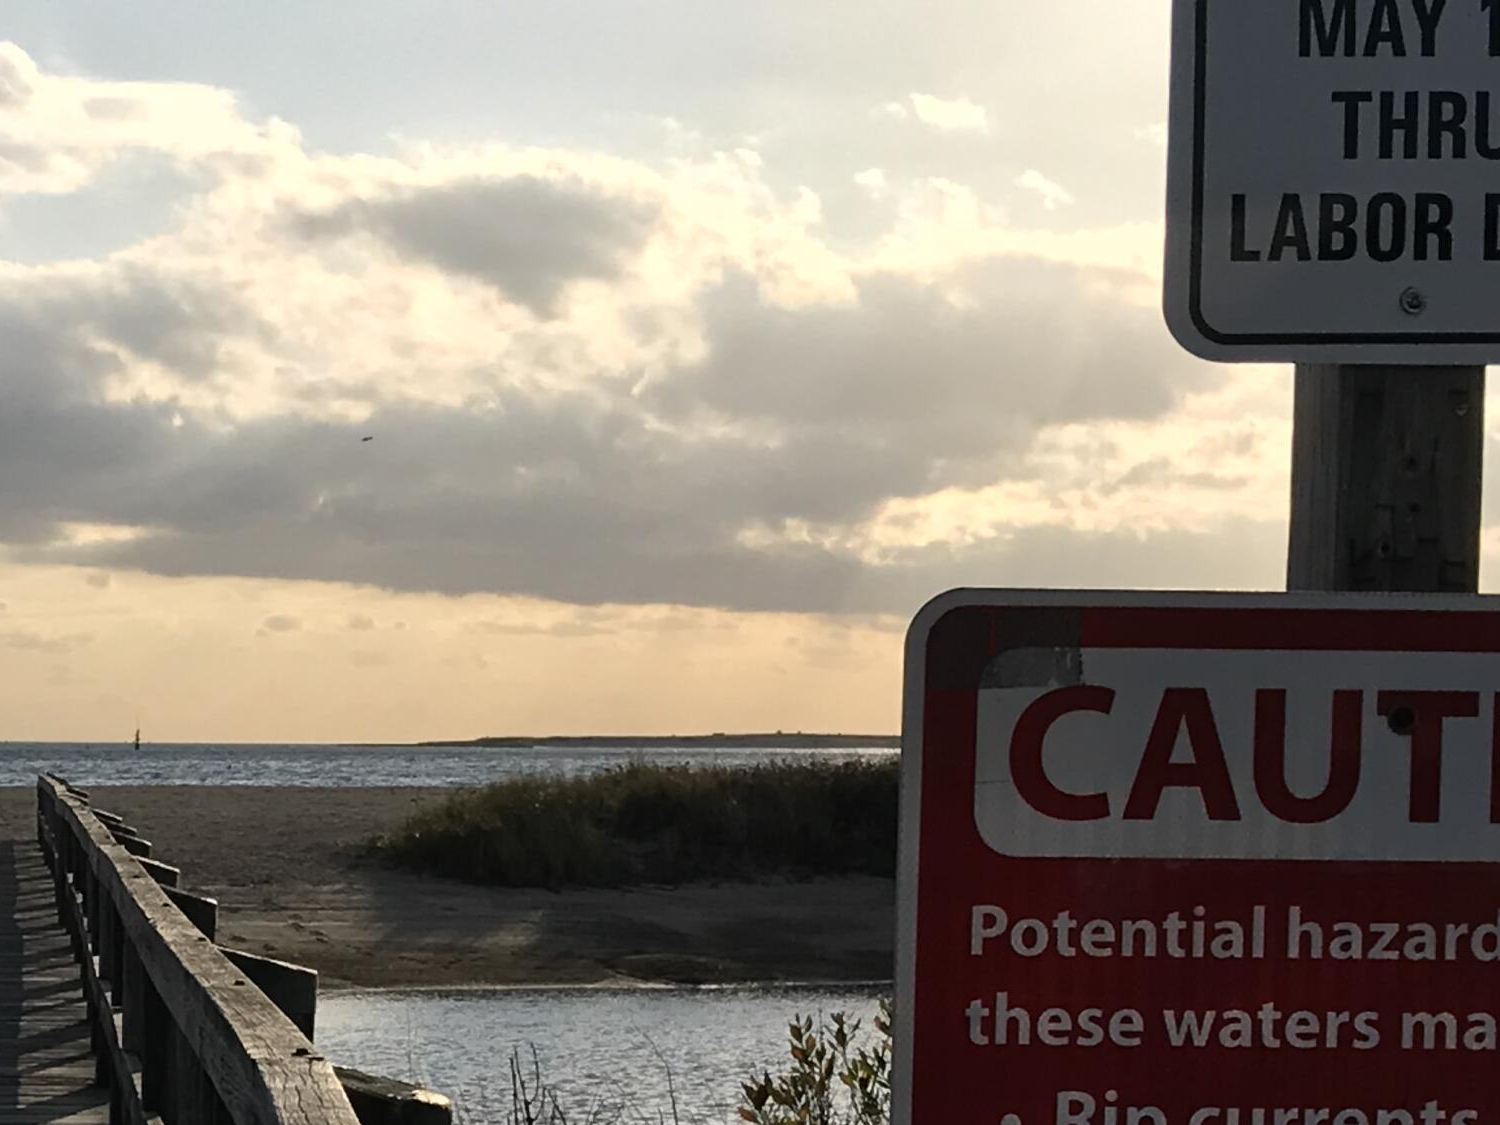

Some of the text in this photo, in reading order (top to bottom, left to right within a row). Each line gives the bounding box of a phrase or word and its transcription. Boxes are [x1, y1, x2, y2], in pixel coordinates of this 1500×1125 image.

[1299, 0, 1446, 57] MAY
[1332, 91, 1500, 160] THRU
[1231, 192, 1453, 262] LABOR
[971, 905, 1265, 958] Potential
[966, 992, 1143, 1046] these
[1163, 1002, 1379, 1049] waters
